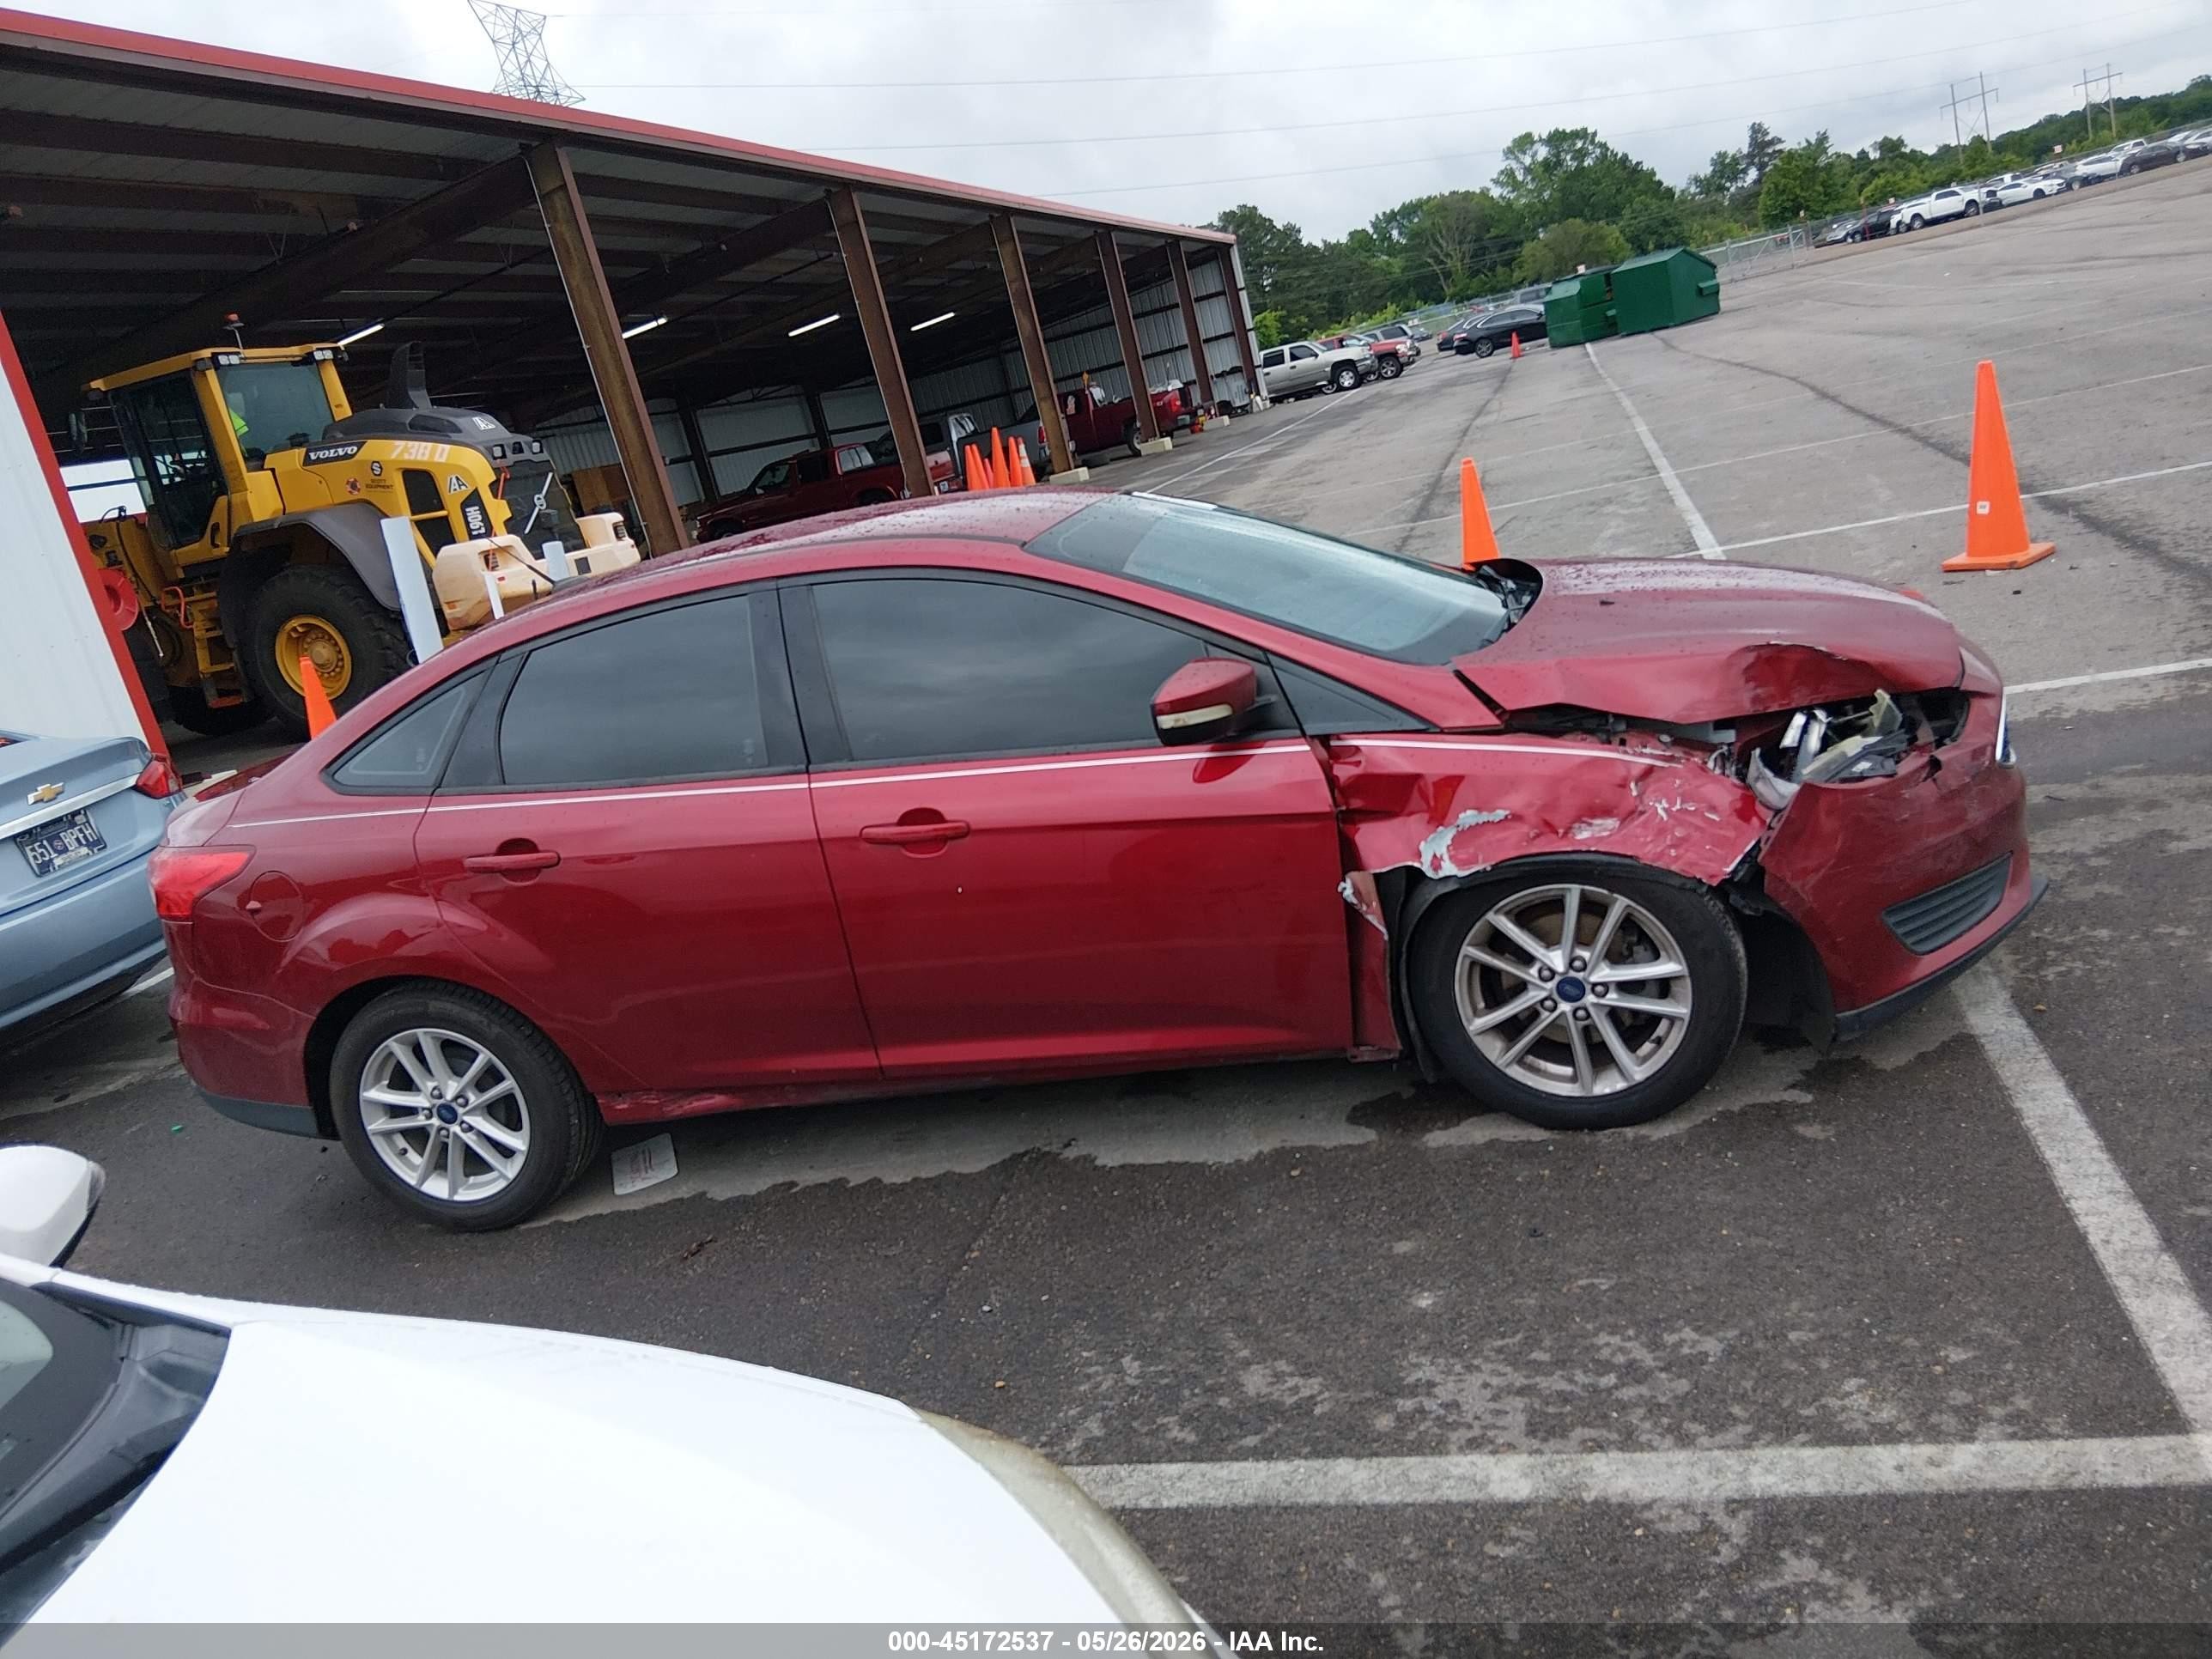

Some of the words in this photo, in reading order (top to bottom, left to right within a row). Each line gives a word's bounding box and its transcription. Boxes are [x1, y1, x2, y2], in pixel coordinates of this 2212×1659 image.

[308, 446, 358, 460] VOLVO
[465, 506, 486, 536] L90H
[59, 823, 97, 851] BPFH
